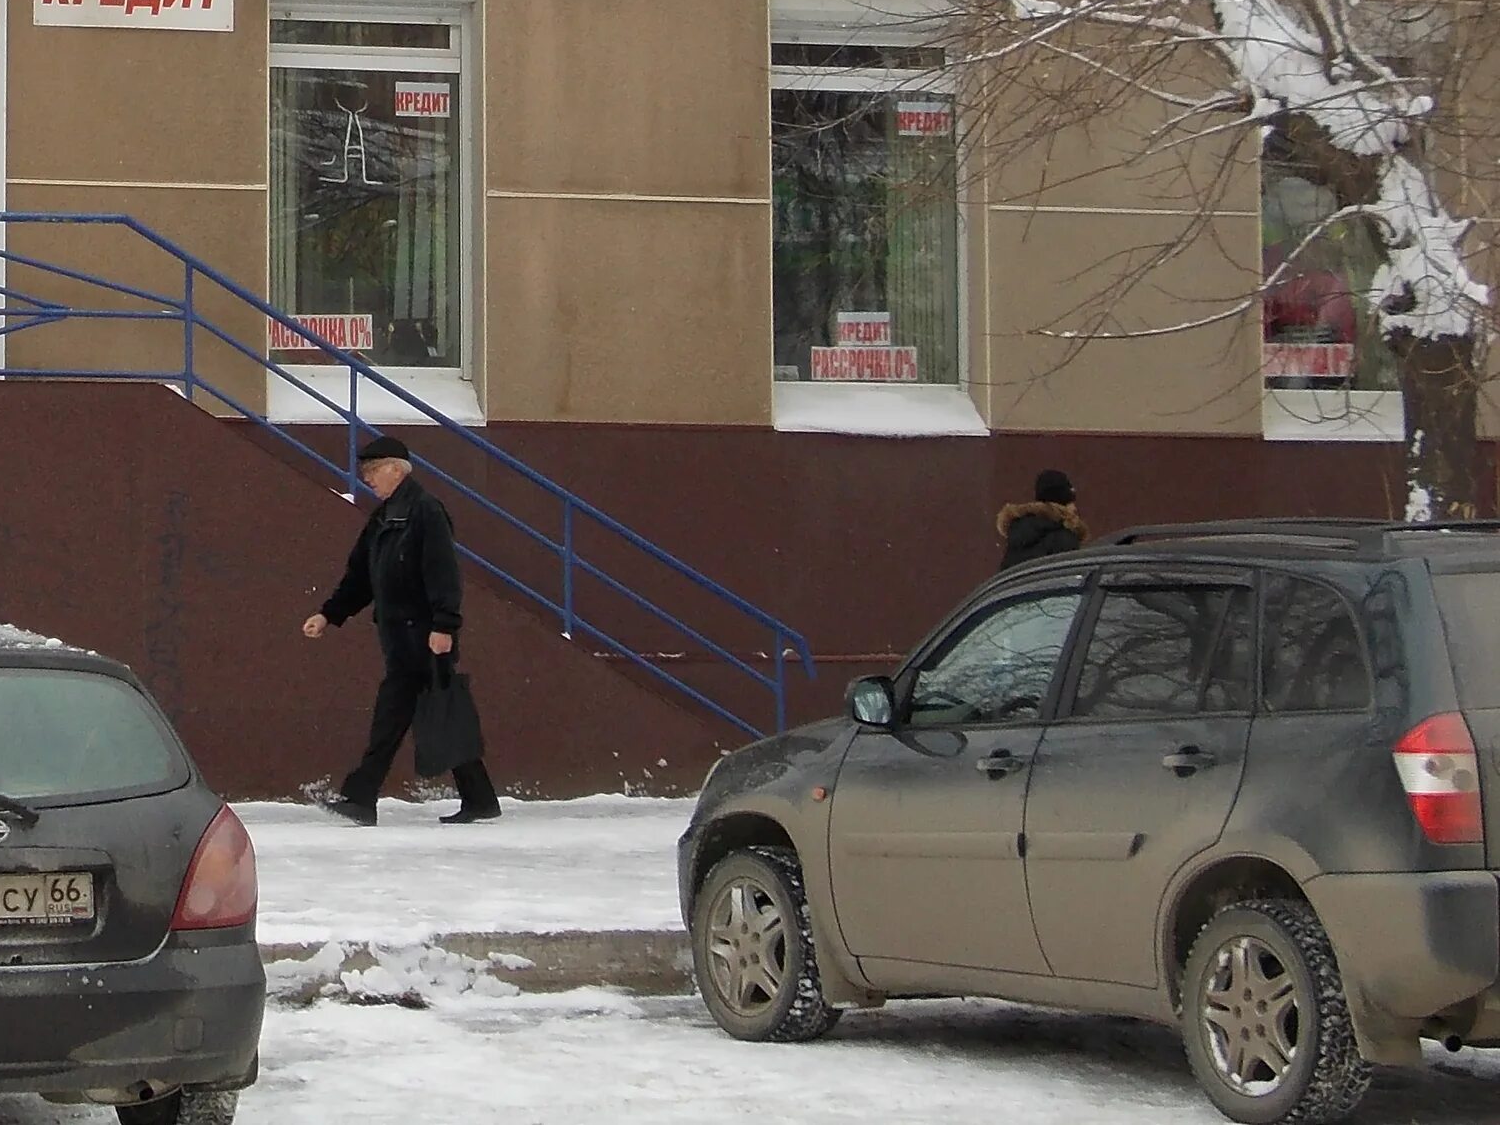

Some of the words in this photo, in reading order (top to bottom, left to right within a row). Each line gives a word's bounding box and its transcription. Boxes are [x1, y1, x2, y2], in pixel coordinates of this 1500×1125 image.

[396, 92, 449, 115] КРЕДИТ
[896, 112, 949, 133] КРЕДИТ
[350, 317, 372, 348] 0%
[837, 322, 888, 343] КРЕДИТ
[812, 348, 891, 379] РАССРОЧКА
[895, 348, 917, 379] 0%
[50, 878, 80, 903] 66
[49, 904, 72, 915] RUS
